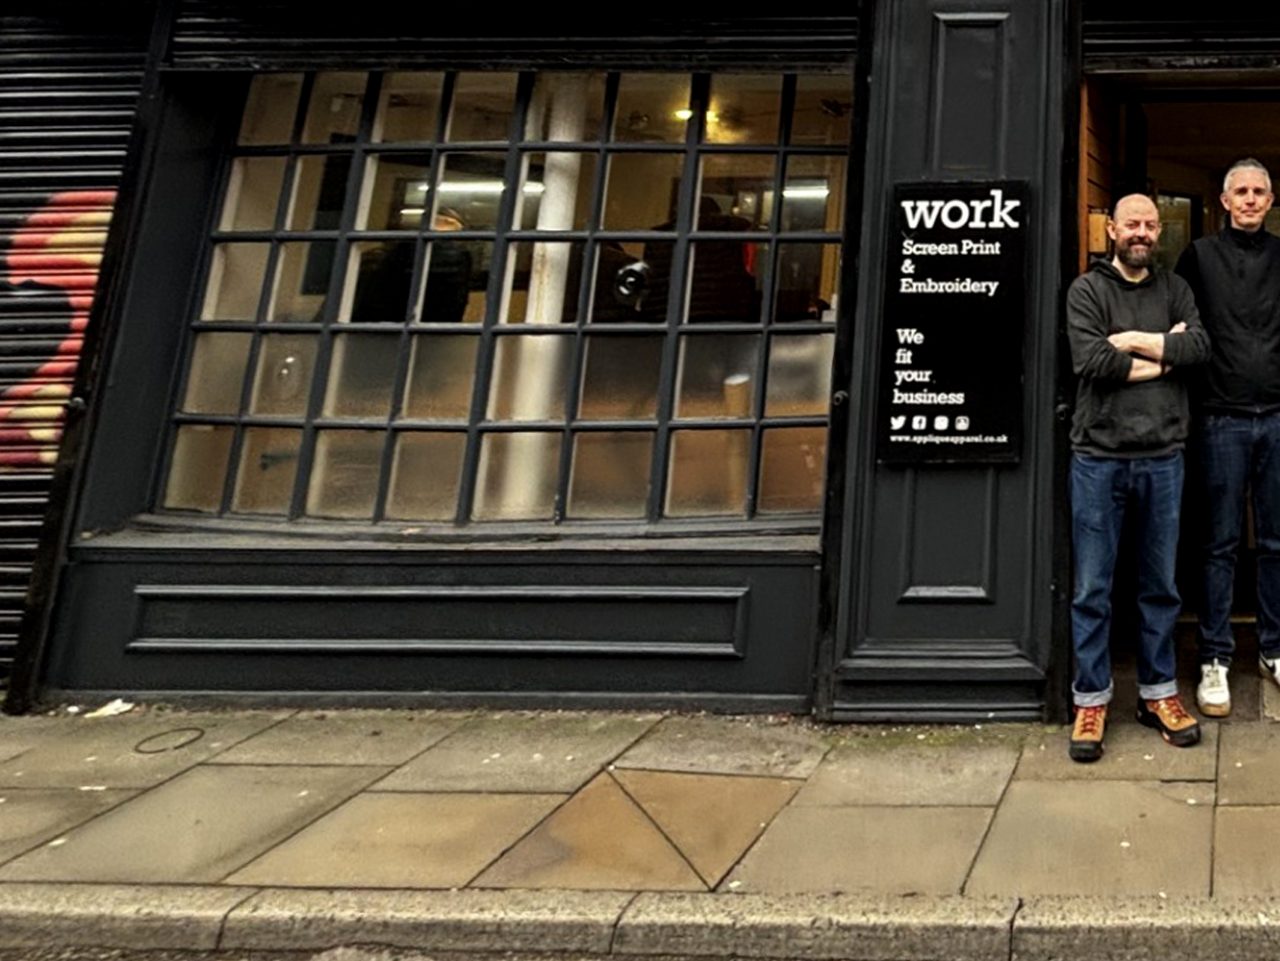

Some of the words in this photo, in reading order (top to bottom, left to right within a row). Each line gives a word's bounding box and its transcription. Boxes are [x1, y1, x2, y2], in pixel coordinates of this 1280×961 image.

[901, 190, 1020, 228] work
[903, 239, 958, 255] Screen
[961, 240, 1000, 254] Print
[901, 259, 915, 273] &
[900, 278, 999, 296] Embroidery
[897, 329, 924, 344] We
[896, 349, 912, 363] fit
[895, 370, 932, 385] your
[893, 389, 964, 404] business
